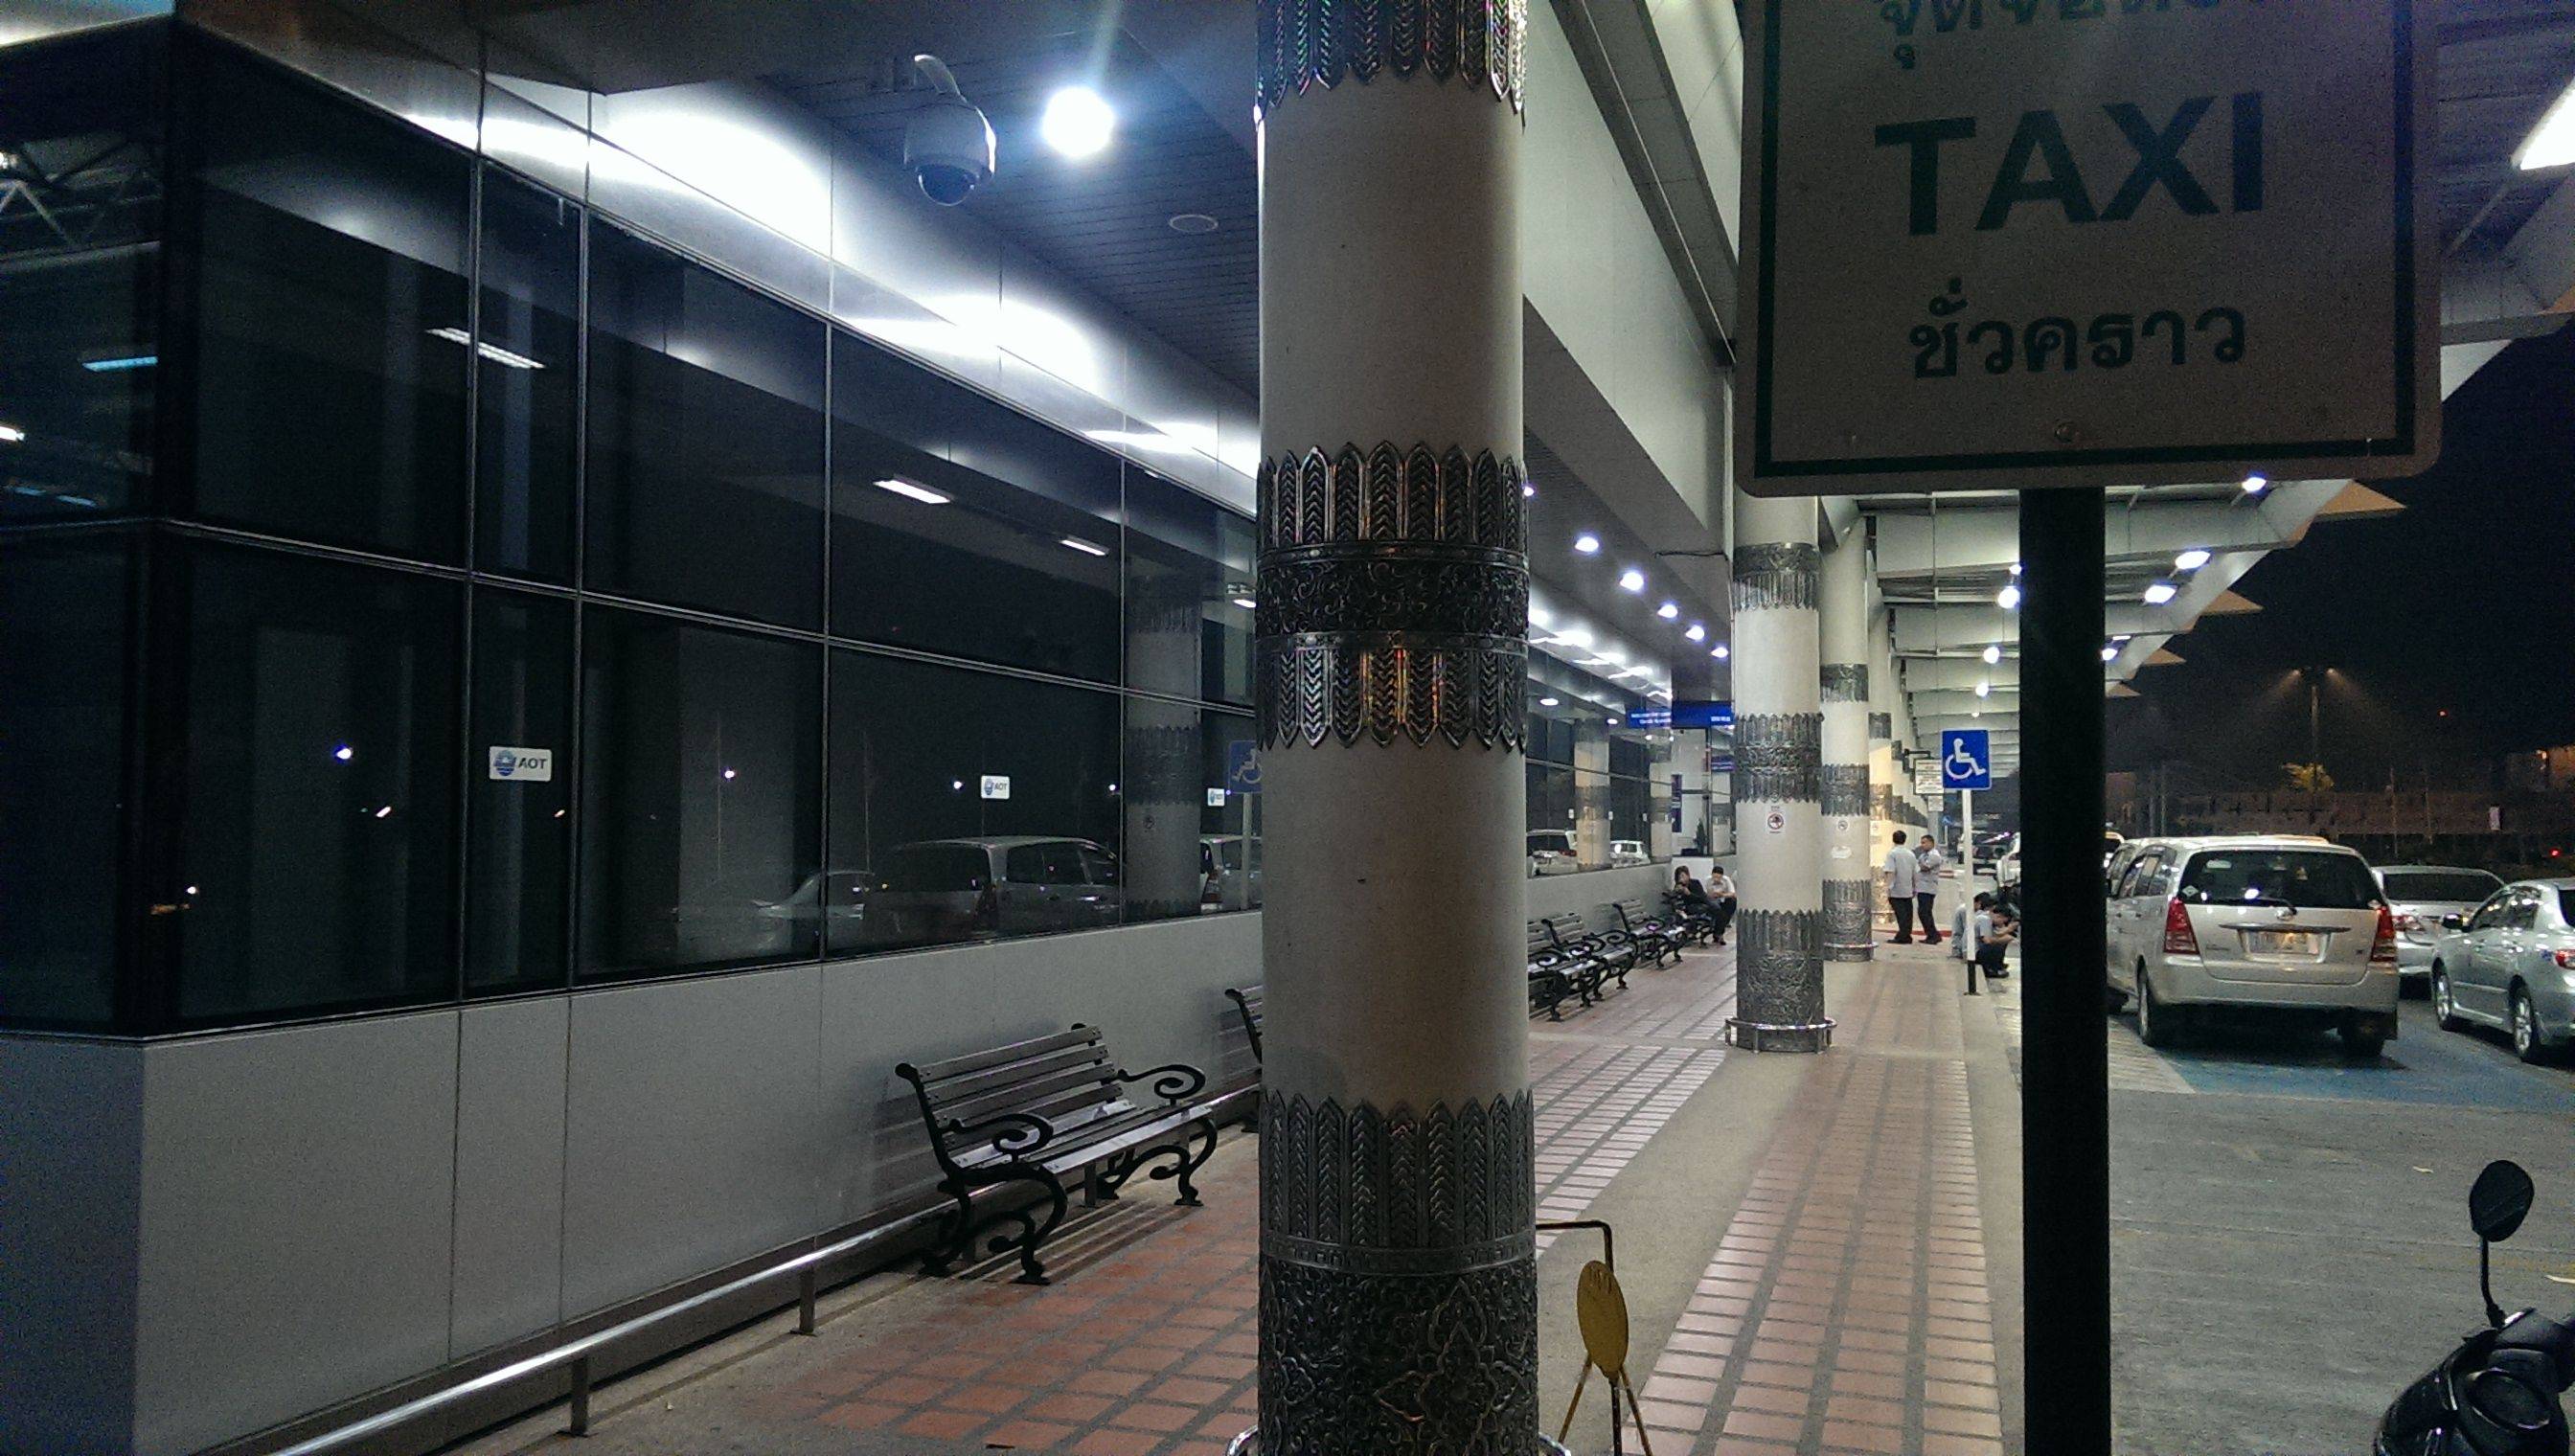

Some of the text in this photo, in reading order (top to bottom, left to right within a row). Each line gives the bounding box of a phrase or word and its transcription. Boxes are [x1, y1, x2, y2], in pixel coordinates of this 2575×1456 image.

[1875, 92, 2264, 236] TAXI
[1908, 277, 2247, 379] ชั่วคราว
[518, 757, 548, 769] AOT
